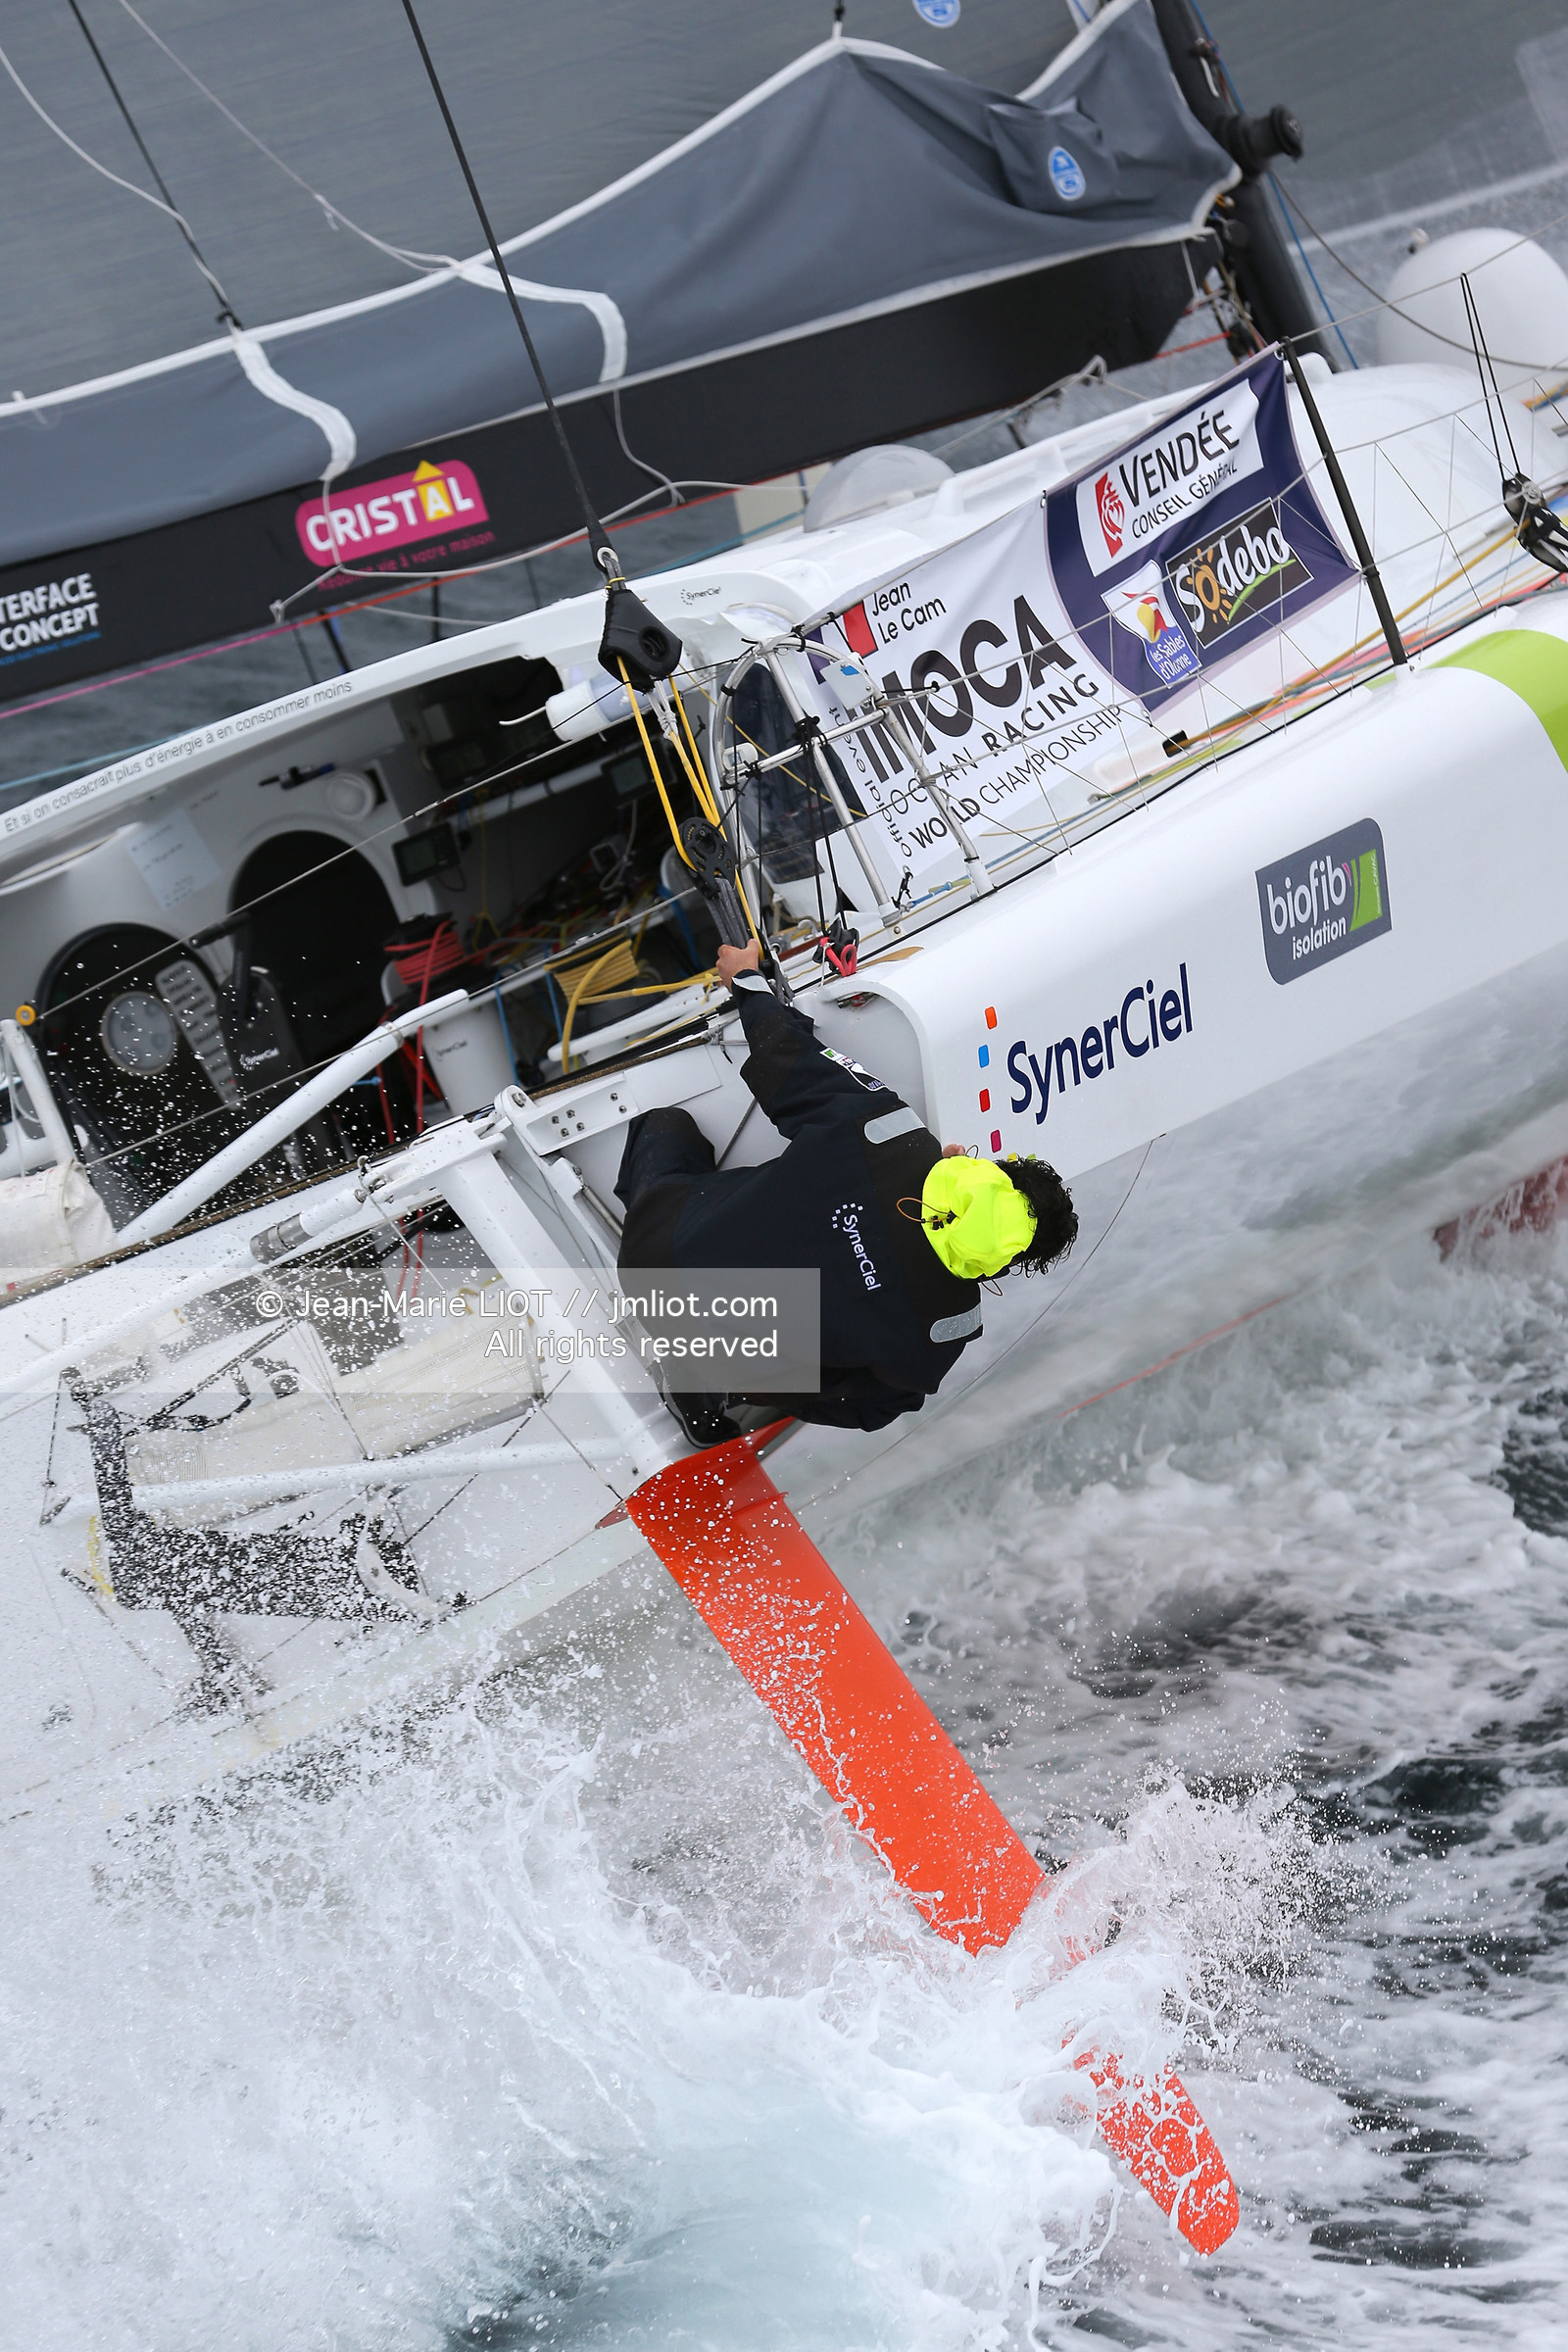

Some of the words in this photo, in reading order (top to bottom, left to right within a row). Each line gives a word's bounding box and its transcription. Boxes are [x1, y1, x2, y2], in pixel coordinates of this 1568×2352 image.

[1119, 410, 1240, 508] VENDÉE
[306, 476, 475, 552] CRISTAL
[1132, 494, 1193, 538] CONSEIL
[0, 572, 97, 624] TERFACE
[0, 602, 99, 652] CONCEPT
[872, 582, 911, 615] Jean
[878, 622, 899, 644] Le
[901, 597, 947, 630] Cam
[1156, 635, 1185, 658] Sables
[5, 816, 19, 832] Et
[33, 806, 49, 819] on
[51, 771, 116, 809] consacrait
[115, 760, 141, 783] plus
[145, 736, 202, 767] d'énergie
[206, 730, 215, 744] à
[217, 724, 232, 739] en
[235, 695, 310, 732] consommer
[314, 681, 352, 704] moins
[891, 747, 978, 814] OCAN
[982, 673, 1100, 757] RACING
[908, 798, 981, 849] WOLD
[979, 705, 1122, 805] CHAMPIONSHIP
[863, 779, 913, 858] official
[1267, 856, 1347, 935] biofib
[1292, 916, 1347, 961] isolation
[1007, 962, 1193, 1125] SynerCiel
[843, 1214, 882, 1291] SynerCiel
